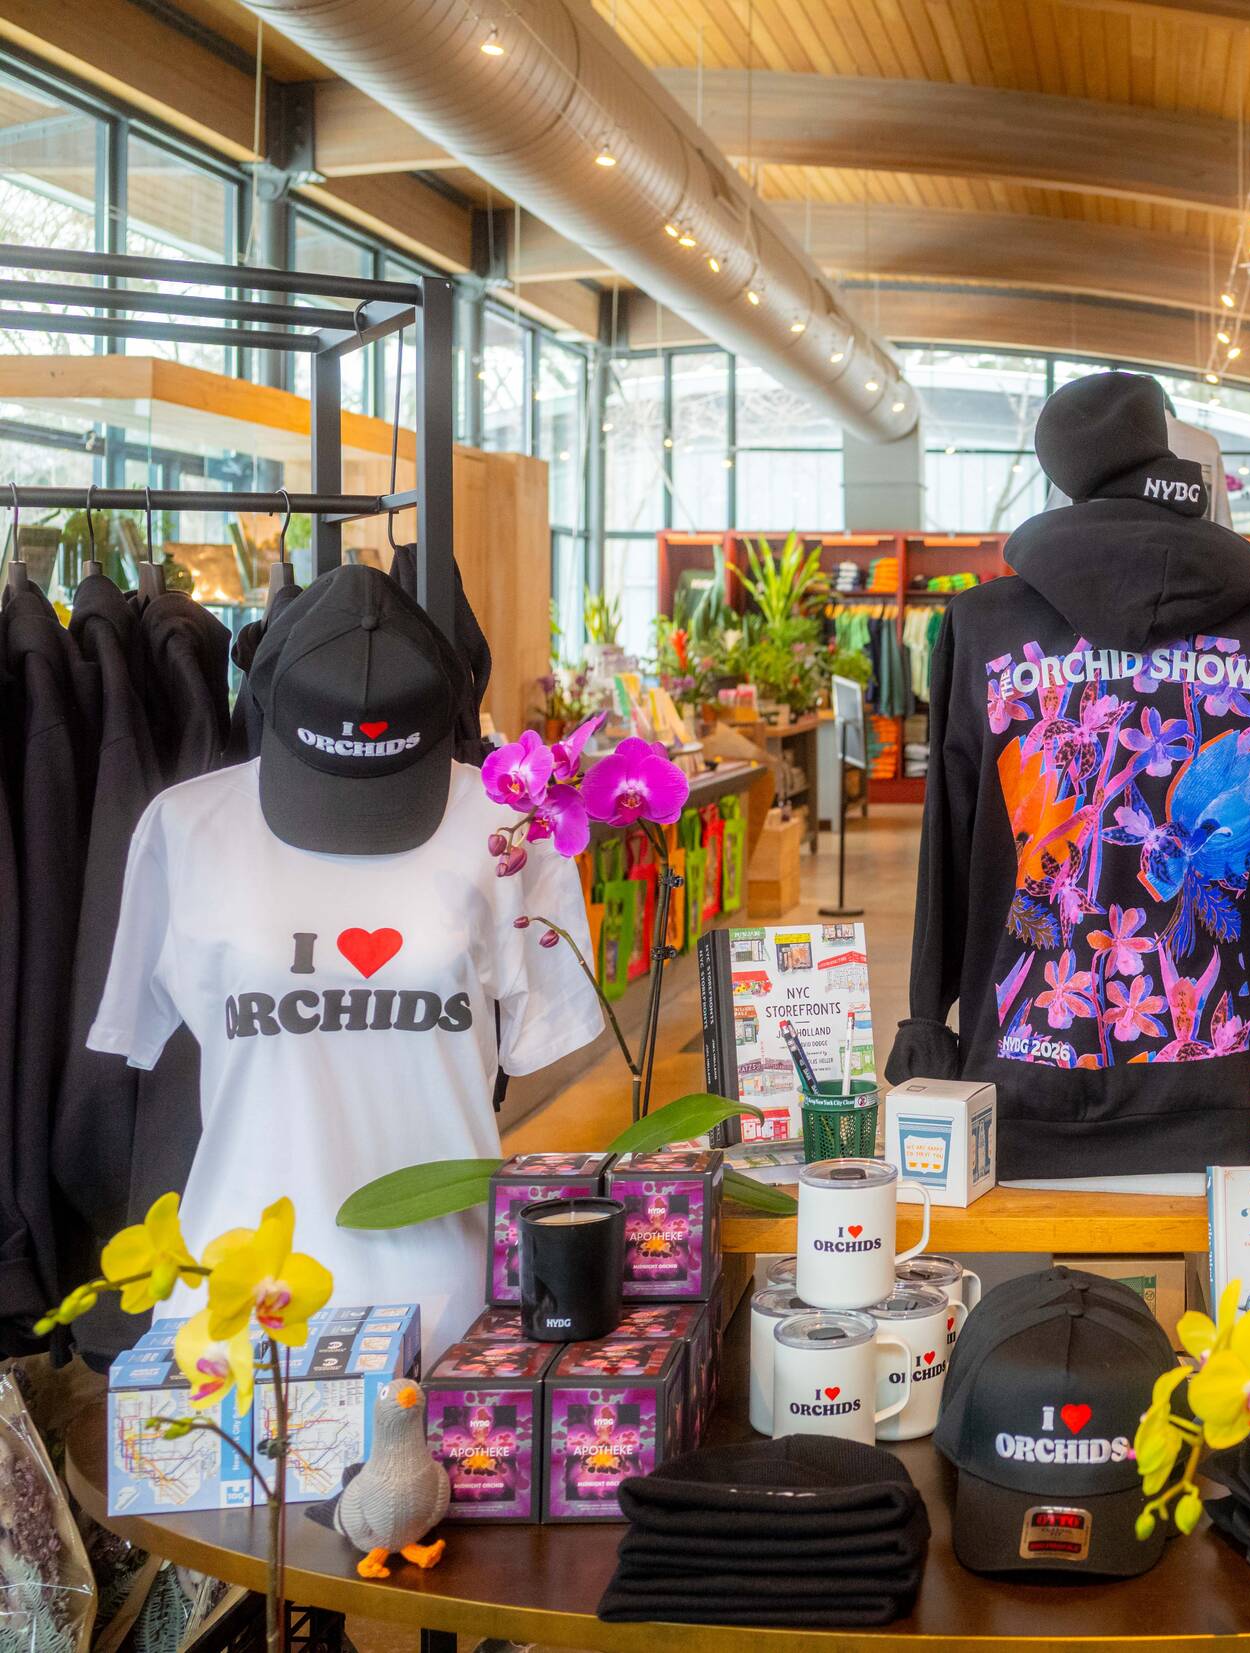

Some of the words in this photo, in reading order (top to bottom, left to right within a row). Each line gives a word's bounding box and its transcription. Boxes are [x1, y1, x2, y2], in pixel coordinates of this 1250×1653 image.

[1143, 477, 1201, 503] NYBG
[1001, 668, 1014, 700] THE
[1012, 649, 1143, 693] ORCHID
[342, 721, 354, 736] I
[297, 727, 421, 757] ORCHIDS
[290, 932, 318, 974] I
[787, 987, 810, 999] NYC
[225, 989, 473, 1040] ORCHIDS
[765, 1002, 841, 1018] STOREFRONTS
[1002, 1036, 1029, 1053] NYBG
[1031, 1040, 1071, 1061] 2026
[629, 1231, 683, 1242] APOTHEKE
[838, 1226, 844, 1238] I
[814, 1238, 882, 1253] ORCHIDS
[546, 1318, 571, 1328] NYBG
[915, 1355, 921, 1367] I
[815, 1389, 821, 1400] I
[789, 1399, 861, 1417] ORCHIDS
[1042, 1406, 1055, 1431] I
[449, 1446, 510, 1458] APOTHEKE
[573, 1445, 633, 1456] APOTHEKE
[995, 1432, 1130, 1464] ORCHIDS
